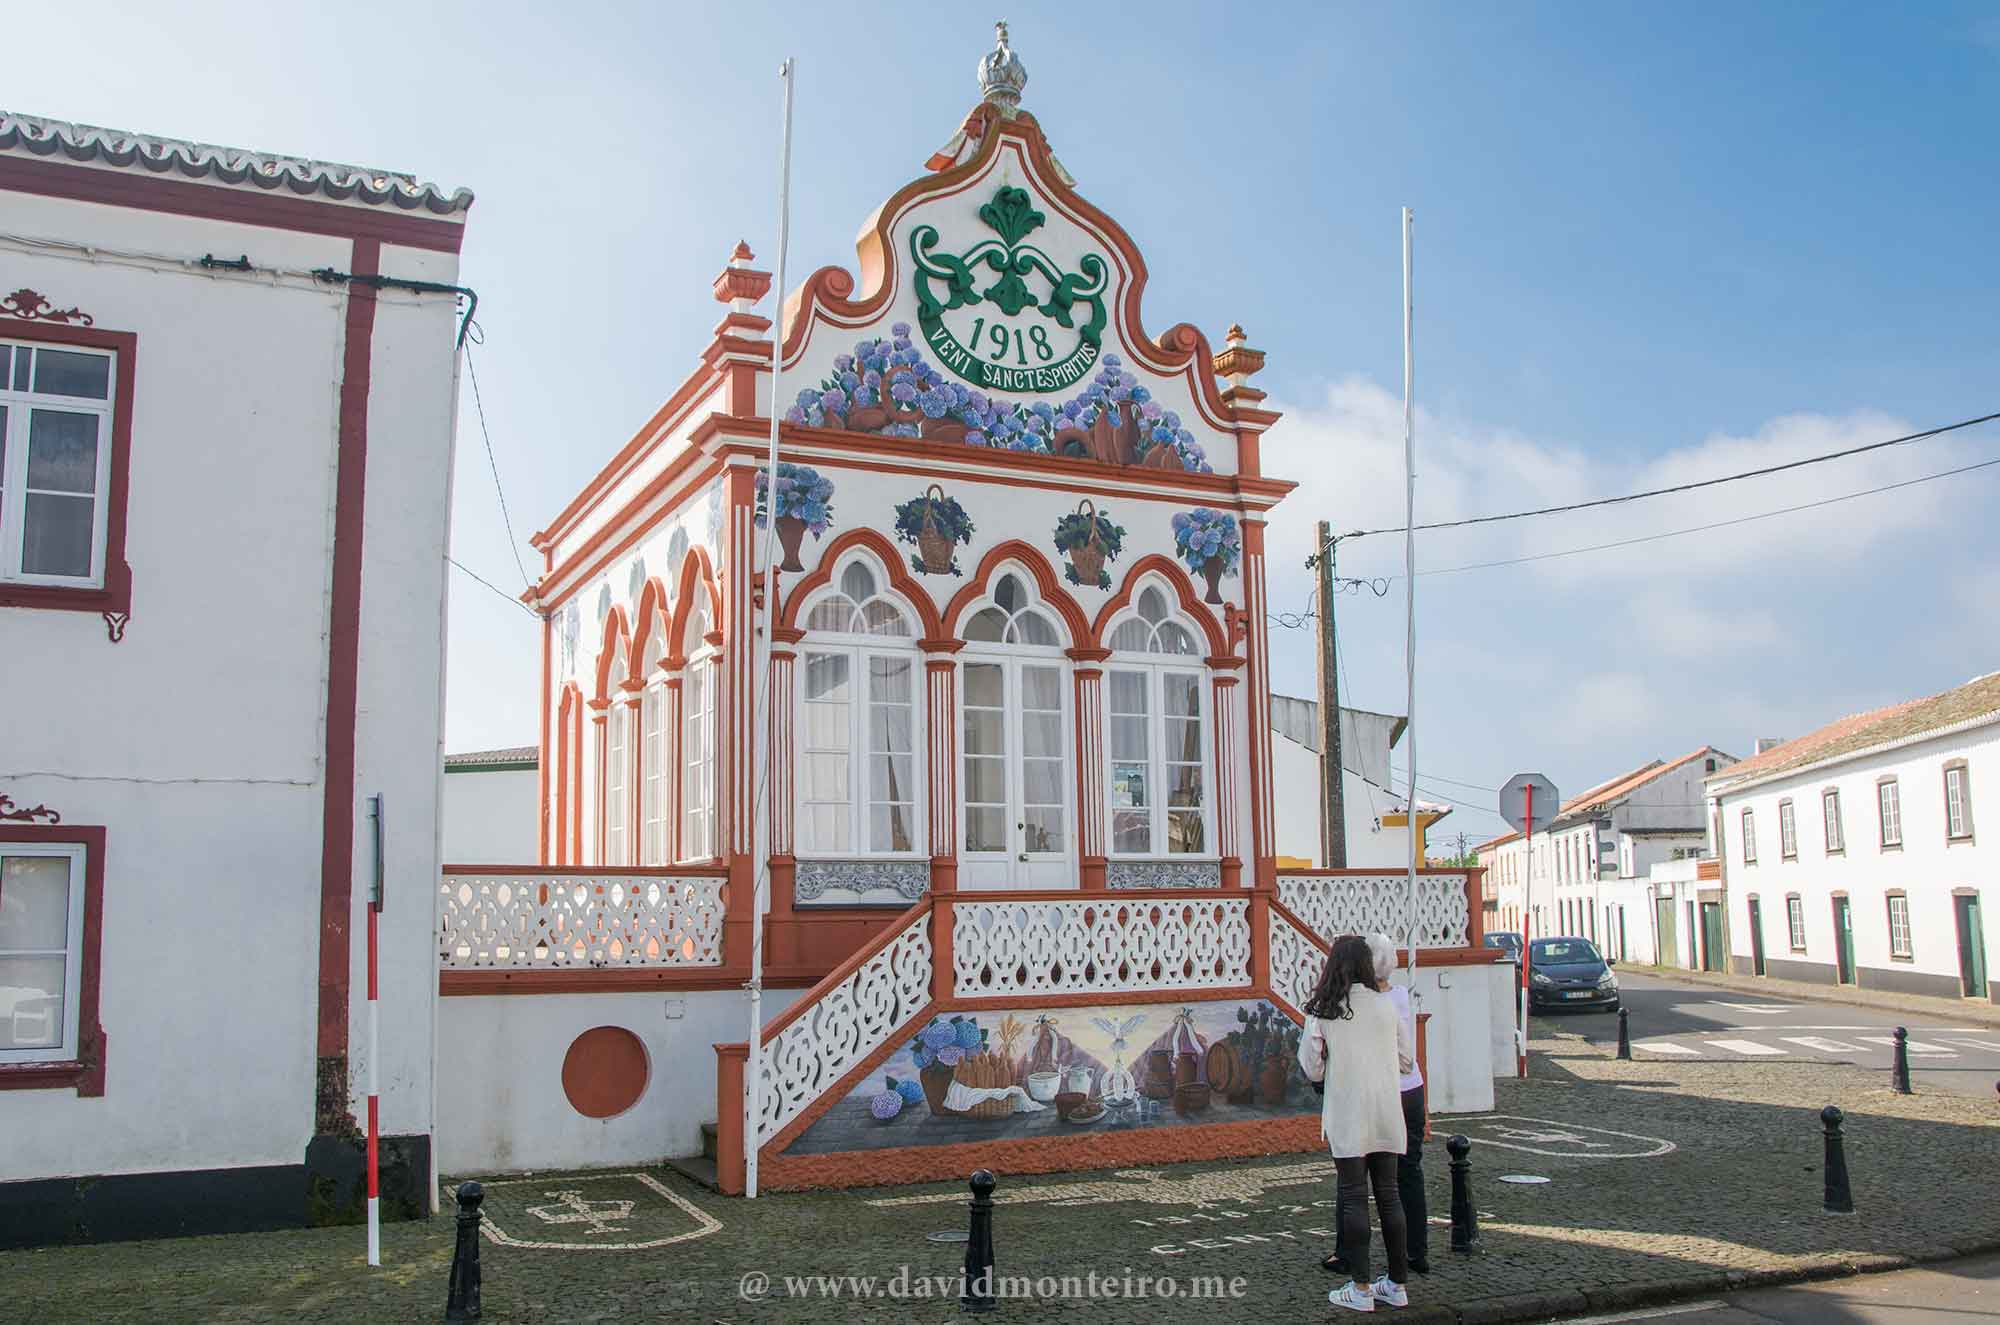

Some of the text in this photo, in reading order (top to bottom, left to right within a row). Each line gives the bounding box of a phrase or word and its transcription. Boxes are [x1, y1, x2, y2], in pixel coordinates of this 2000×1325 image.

[930, 327, 1097, 389] VENI SANCTE SPIRITUS
[969, 317, 1053, 365] 1918
